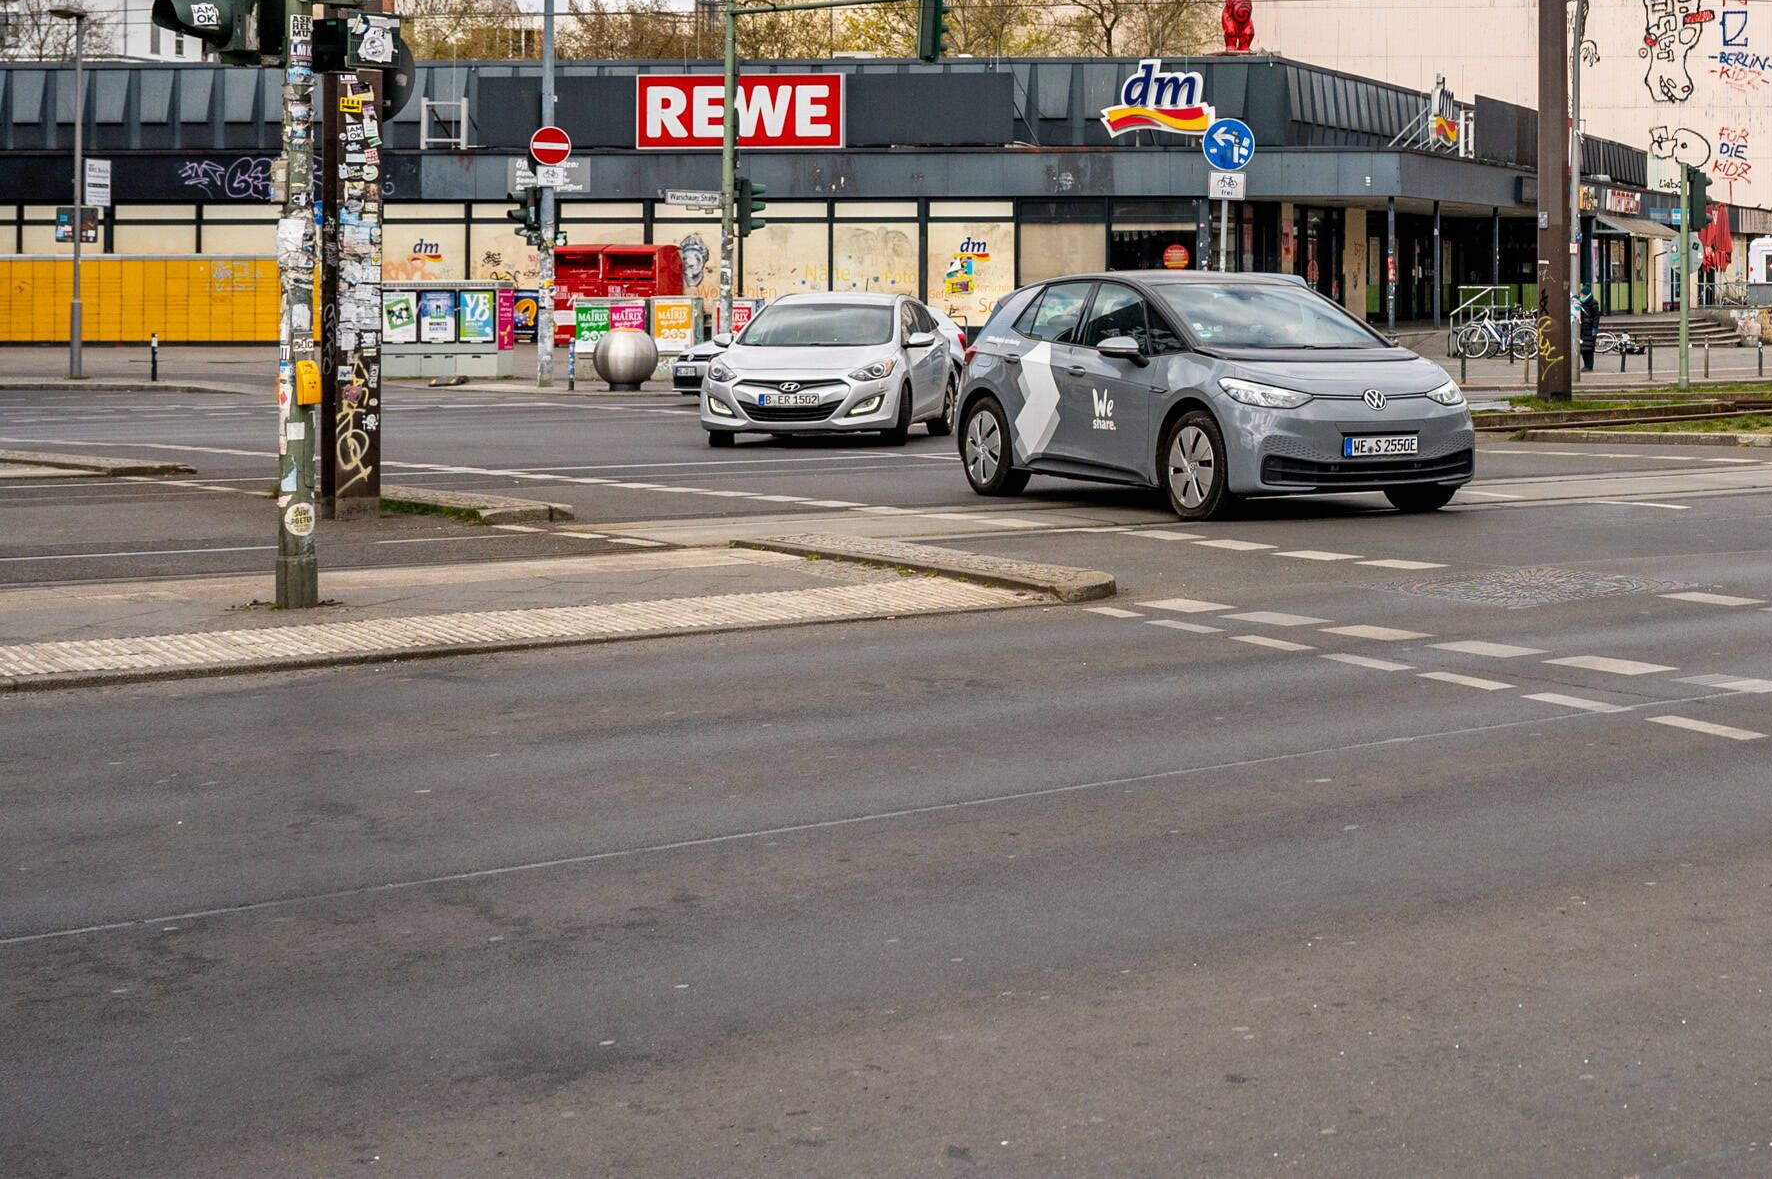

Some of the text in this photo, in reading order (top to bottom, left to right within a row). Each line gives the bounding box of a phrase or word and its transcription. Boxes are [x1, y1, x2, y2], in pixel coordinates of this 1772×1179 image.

[196, 13, 216, 24] OK
[292, 15, 312, 23] ASK
[1123, 63, 1197, 107] dm
[646, 84, 832, 139] REWE
[412, 238, 440, 254] dm
[959, 237, 987, 253] dm
[578, 308, 609, 322] MATRIX
[611, 308, 643, 322] MATRIX
[657, 307, 689, 322] MATRIX
[765, 395, 818, 405] B ER 1502
[1092, 387, 1114, 418] We
[1092, 418, 1117, 431] share.
[1353, 437, 1417, 454] WE S 2550E
